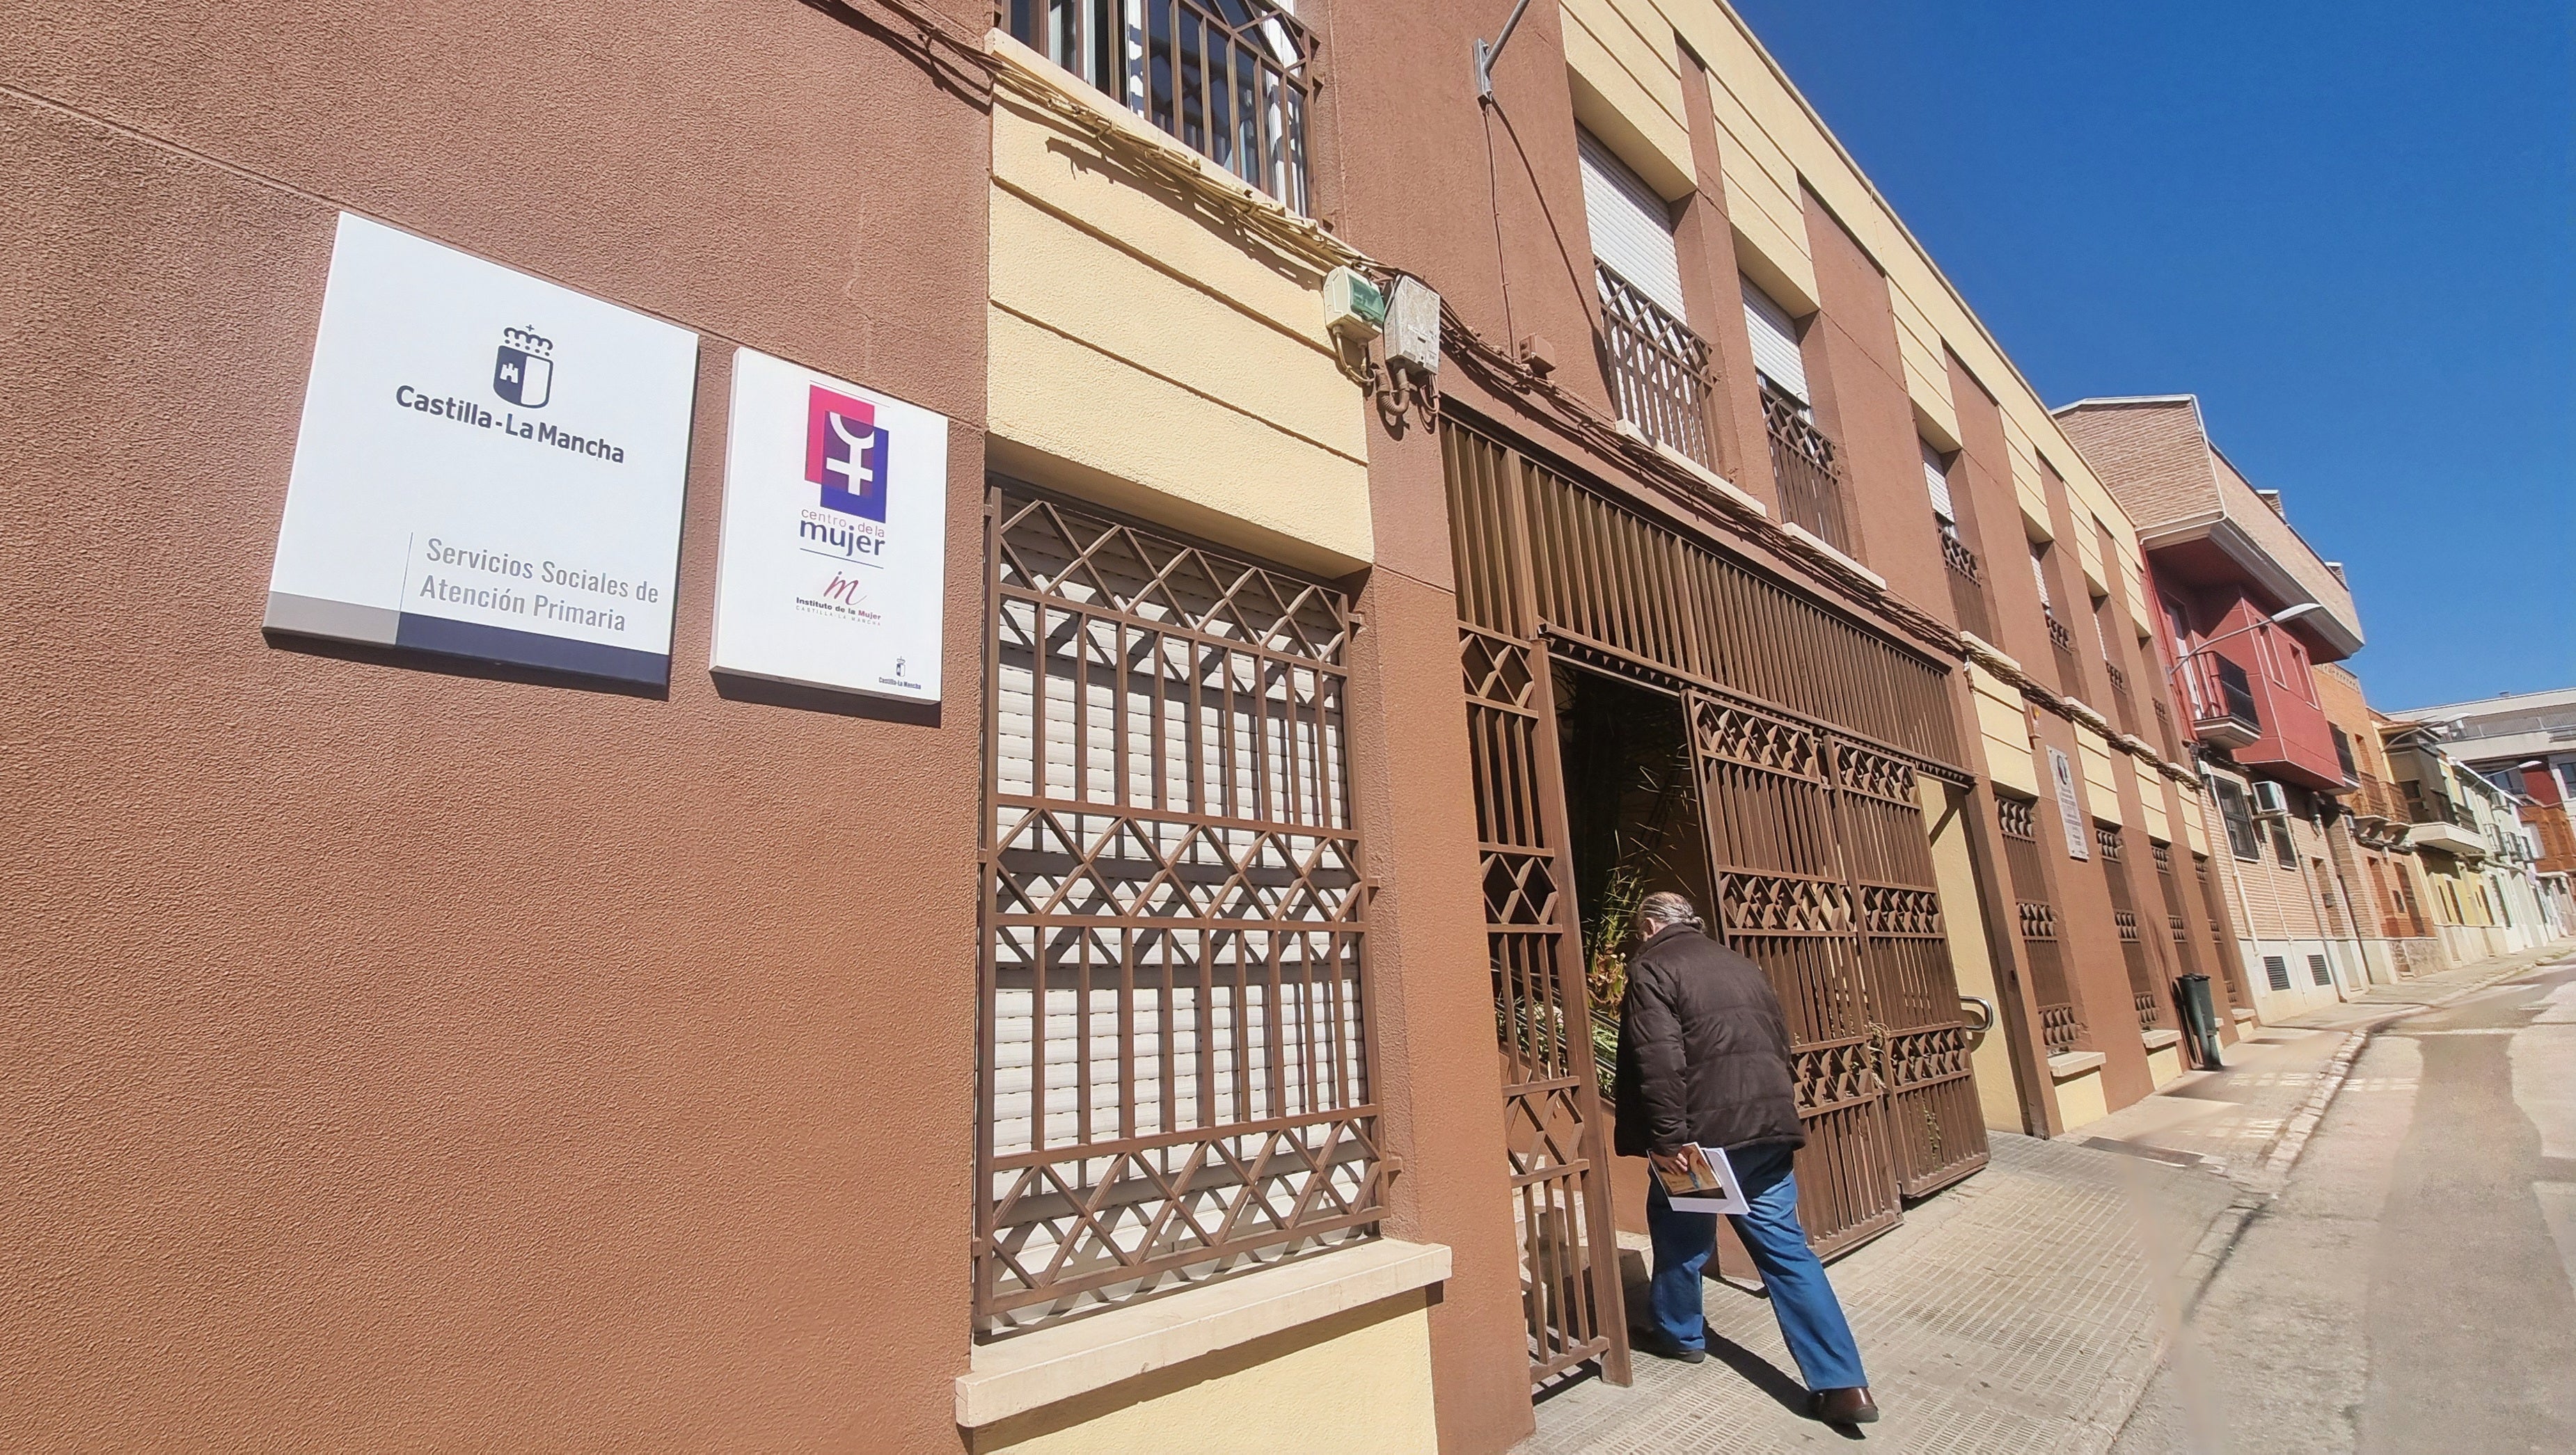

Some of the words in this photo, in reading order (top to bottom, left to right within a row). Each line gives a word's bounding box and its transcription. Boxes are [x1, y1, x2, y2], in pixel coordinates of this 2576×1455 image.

[396, 385, 534, 439] Castilla-La
[537, 422, 624, 463] Mancha
[800, 520, 885, 556] mujer
[801, 509, 846, 527] centro
[858, 523, 873, 534] de
[875, 525, 885, 537] la
[426, 538, 533, 579] Servicios
[541, 561, 629, 598] Sociales
[635, 581, 658, 603] de
[420, 575, 525, 614] Atención
[533, 595, 625, 631] Primaria
[796, 597, 832, 610] Instituto
[858, 610, 881, 620] Mujer
